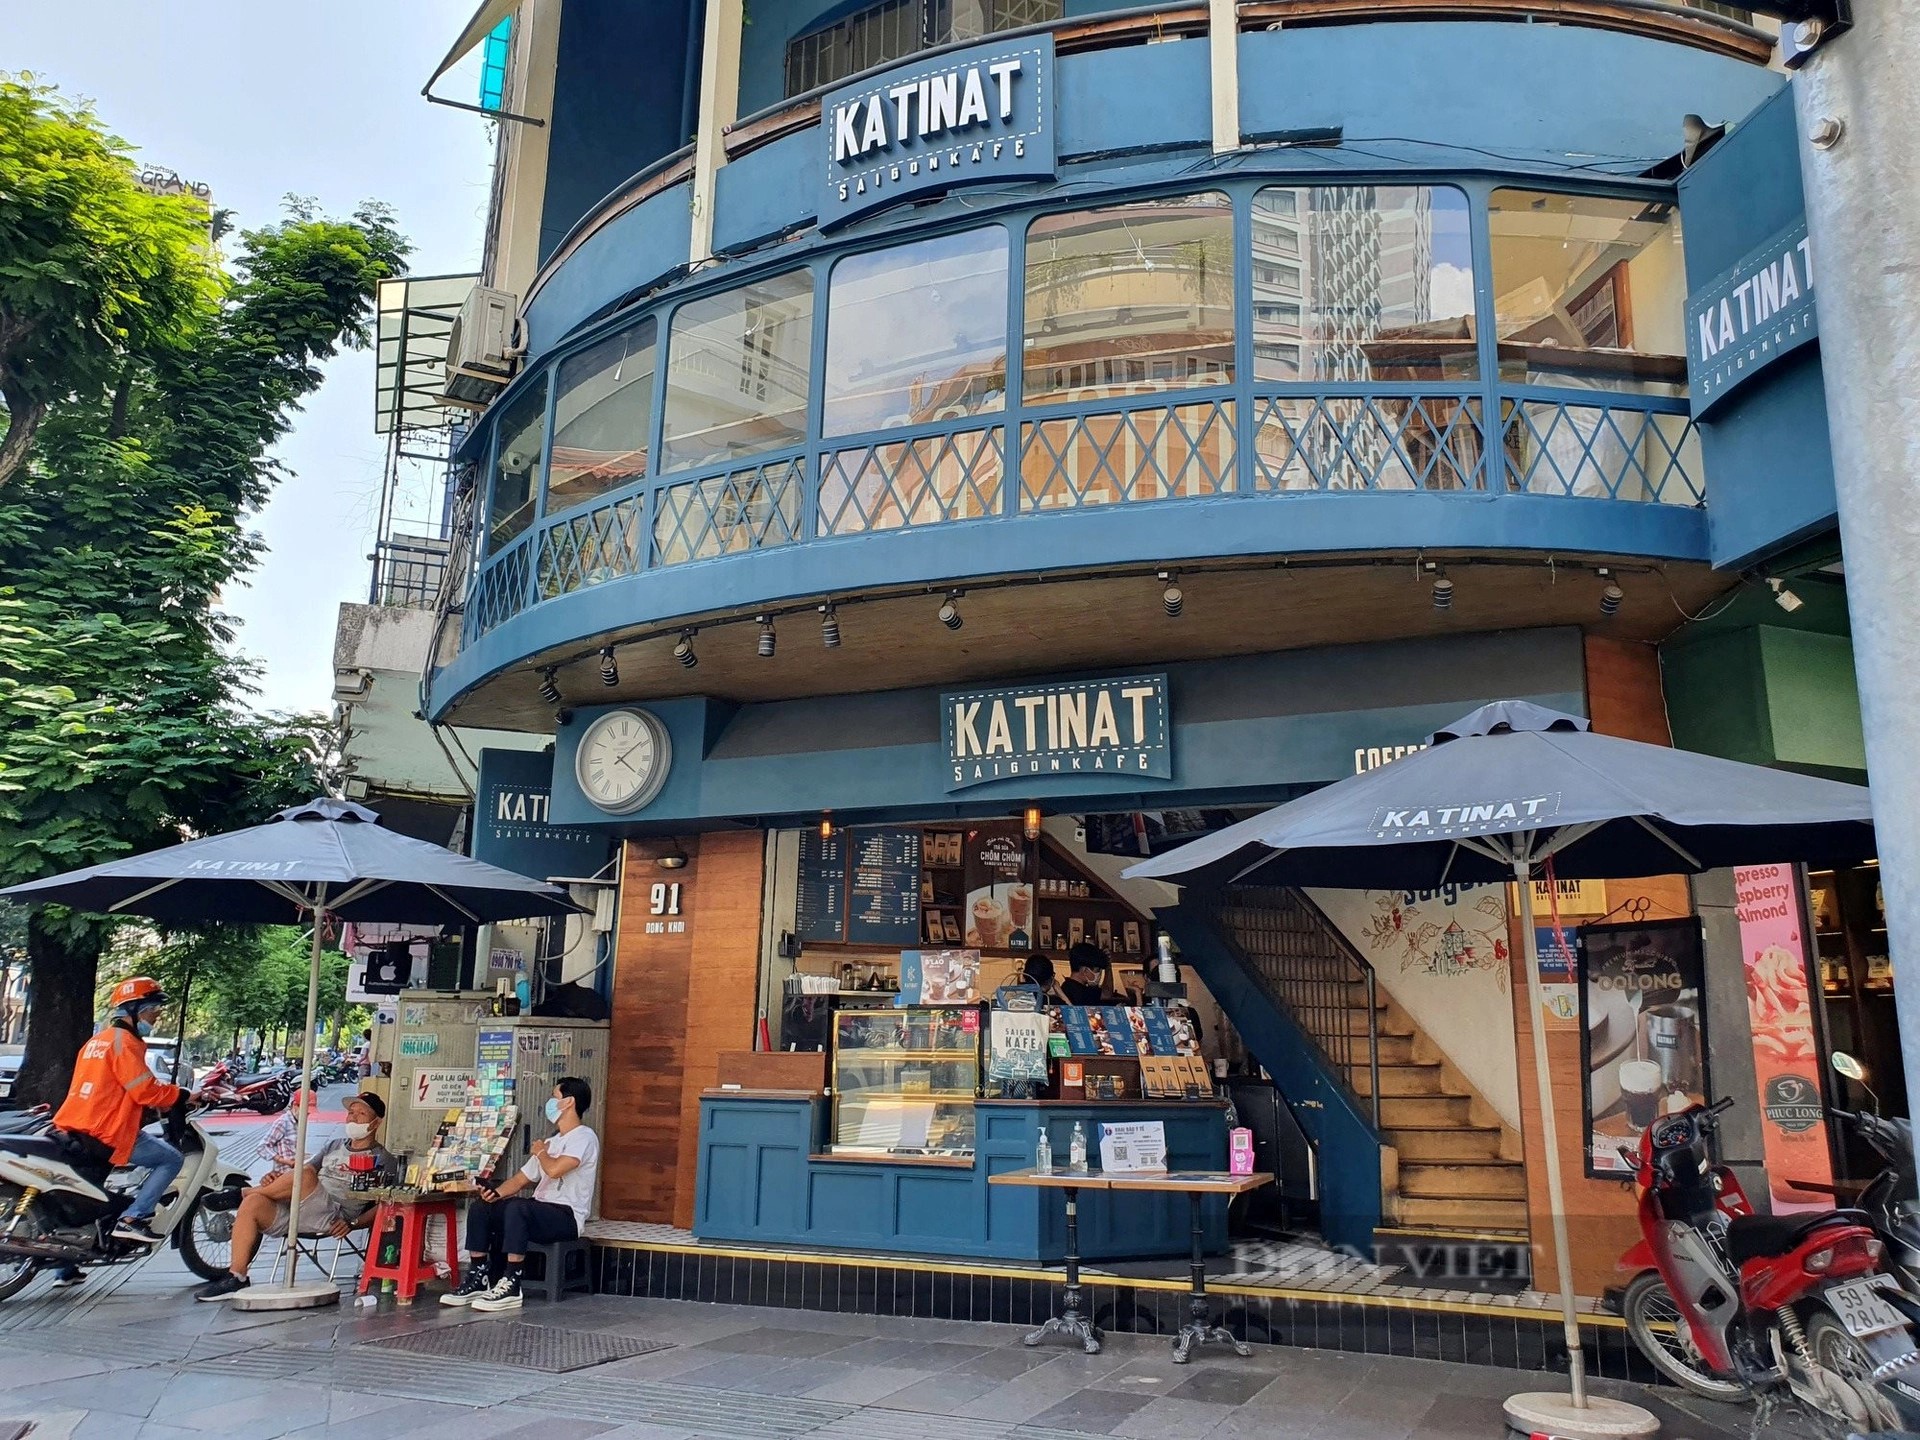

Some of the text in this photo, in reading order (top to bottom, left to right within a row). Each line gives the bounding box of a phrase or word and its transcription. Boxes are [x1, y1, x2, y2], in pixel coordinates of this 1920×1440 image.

[835, 60, 1021, 162] KATINAT
[141, 170, 210, 196] GRAND
[955, 686, 1154, 757] KATINAT
[497, 792, 550, 823] KATI
[1383, 798, 1547, 827] KATINAT
[187, 860, 302, 872] KATINAT
[1736, 866, 1779, 886] presso
[651, 883, 679, 915] 91
[1738, 884, 1789, 905] spberry
[1738, 901, 1788, 923] Almond
[1599, 973, 1682, 991] OOLONG
[1005, 1028, 1036, 1036] SAIGON
[1795, 1107, 1822, 1119] LONG
